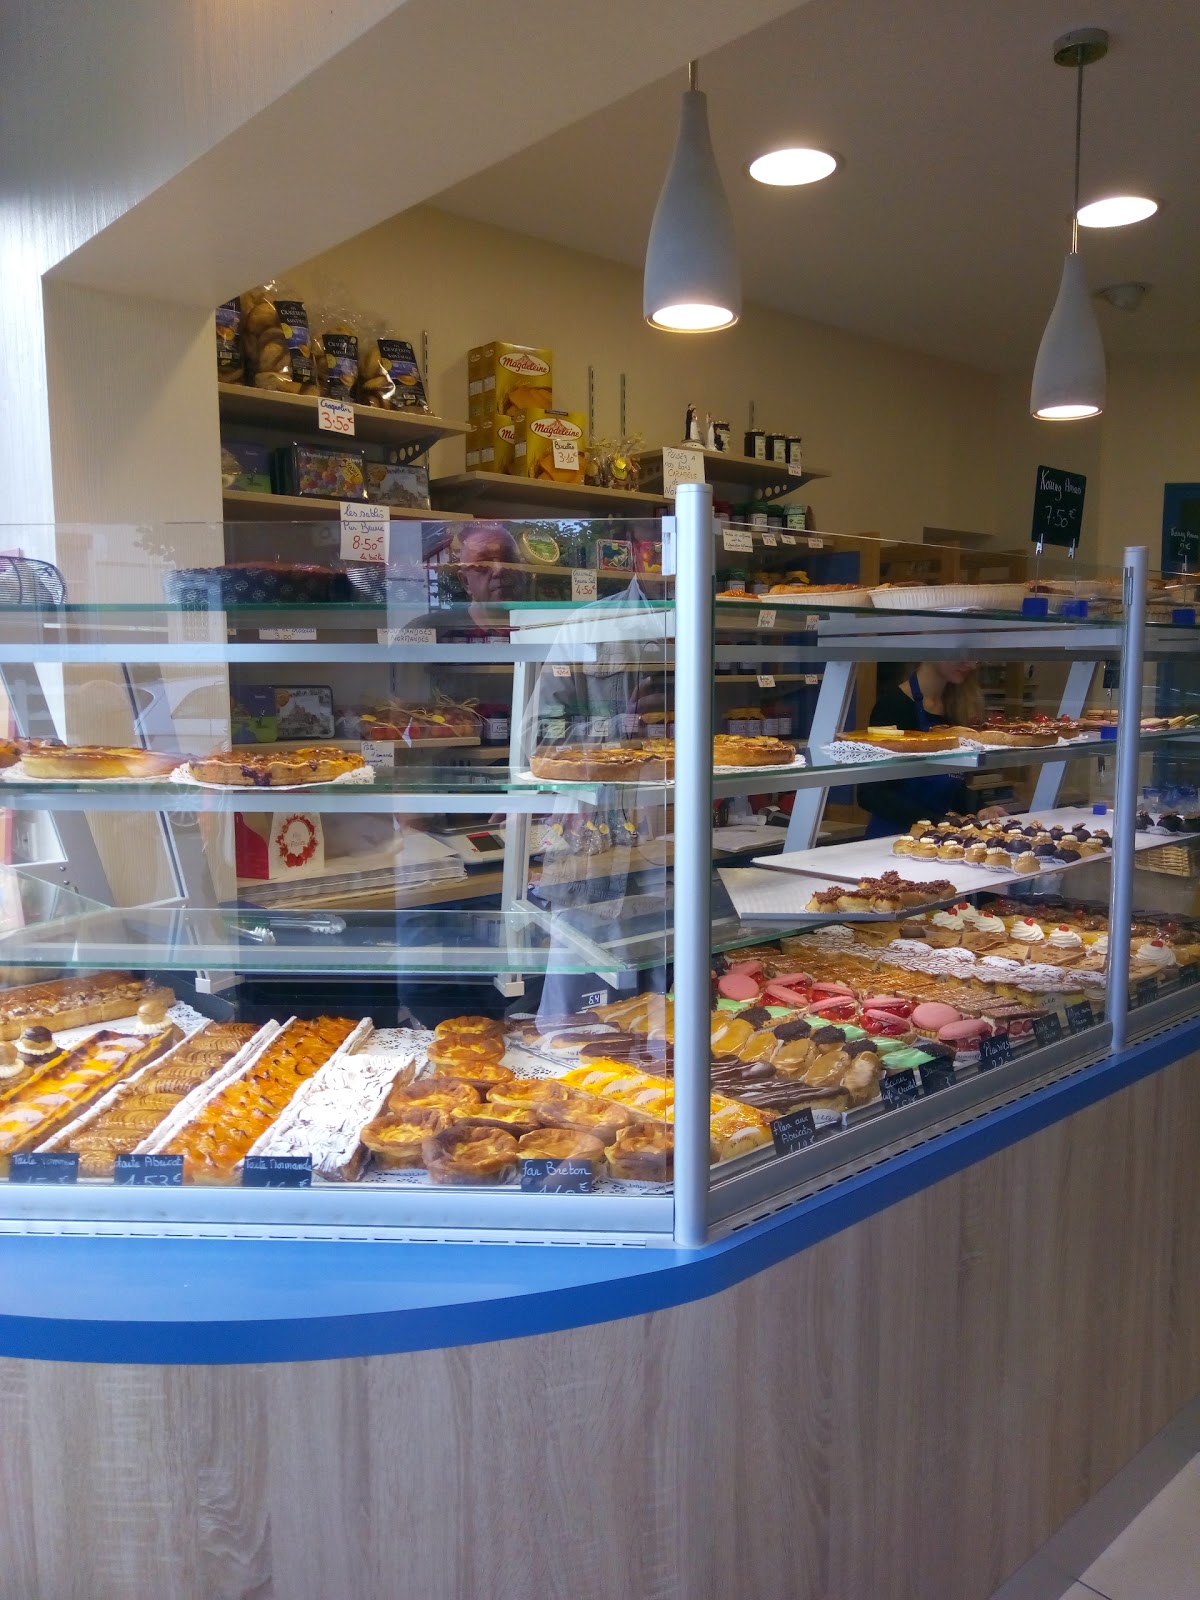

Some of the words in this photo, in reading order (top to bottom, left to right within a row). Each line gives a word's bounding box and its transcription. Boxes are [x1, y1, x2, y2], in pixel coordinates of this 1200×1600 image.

[502, 356, 548, 373] Magdeleine
[321, 411, 354, 432] 3.50€
[534, 422, 580, 438] Magdeleine
[1044, 505, 1077, 528] 7.50€
[352, 535, 384, 551] 8.50€
[545, 1160, 593, 1176] Breton
